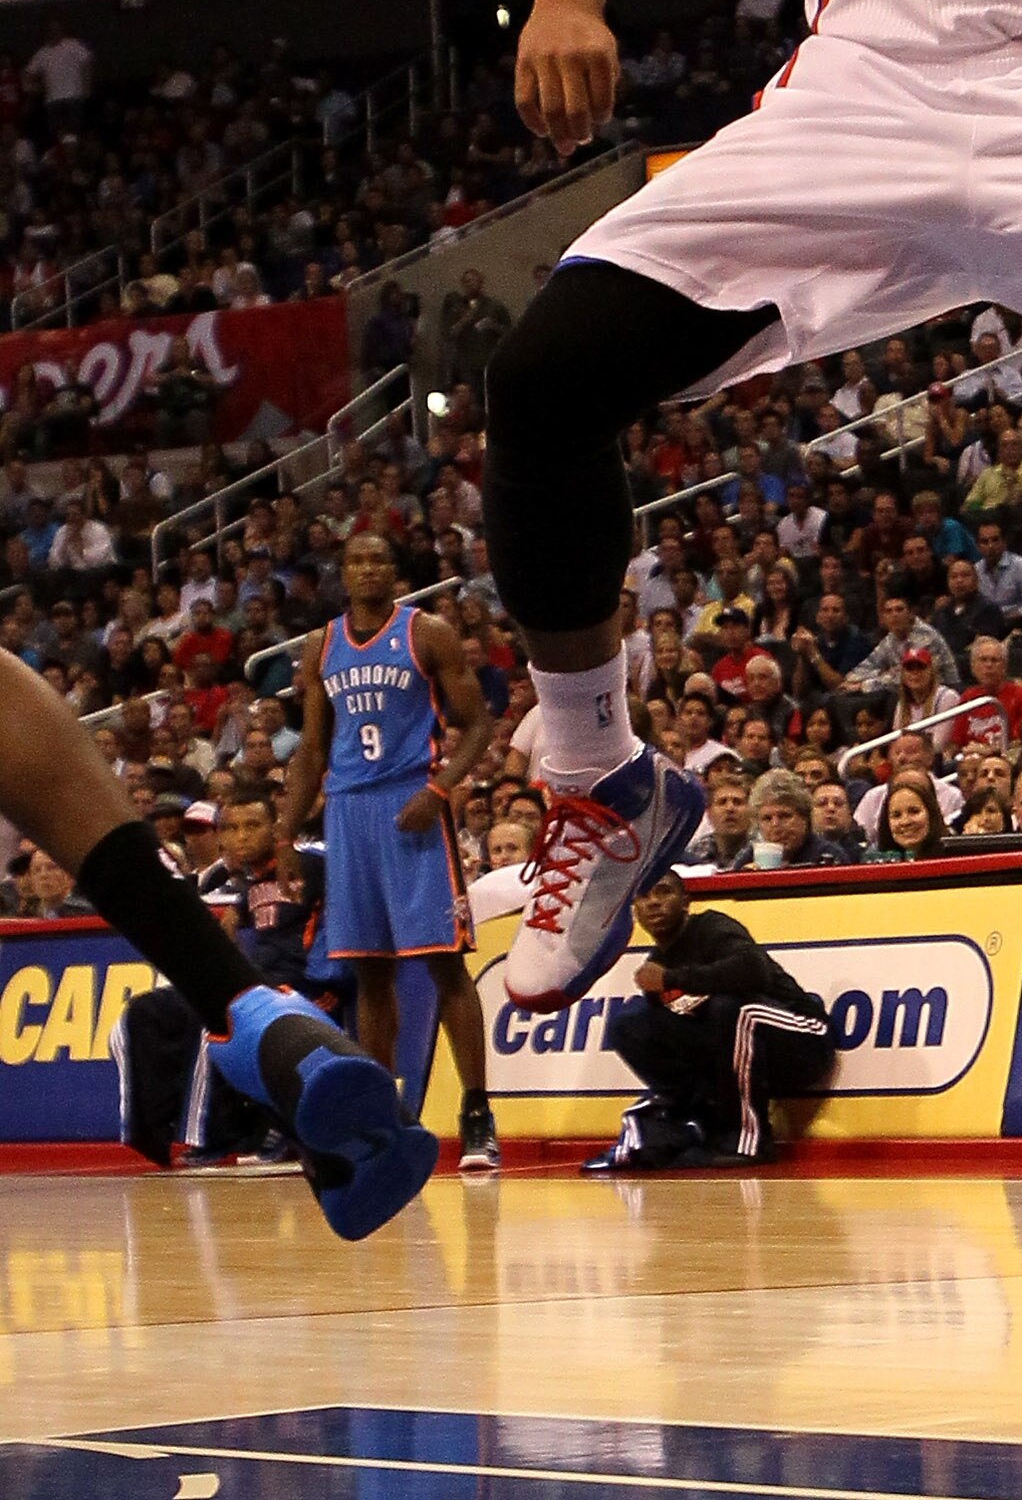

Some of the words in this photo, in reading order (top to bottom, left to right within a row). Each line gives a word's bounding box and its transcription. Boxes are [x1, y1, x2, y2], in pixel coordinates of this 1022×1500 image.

[323, 664, 411, 698] OKLAHOMA
[346, 691, 384, 714] CITY
[360, 724, 381, 761] 9
